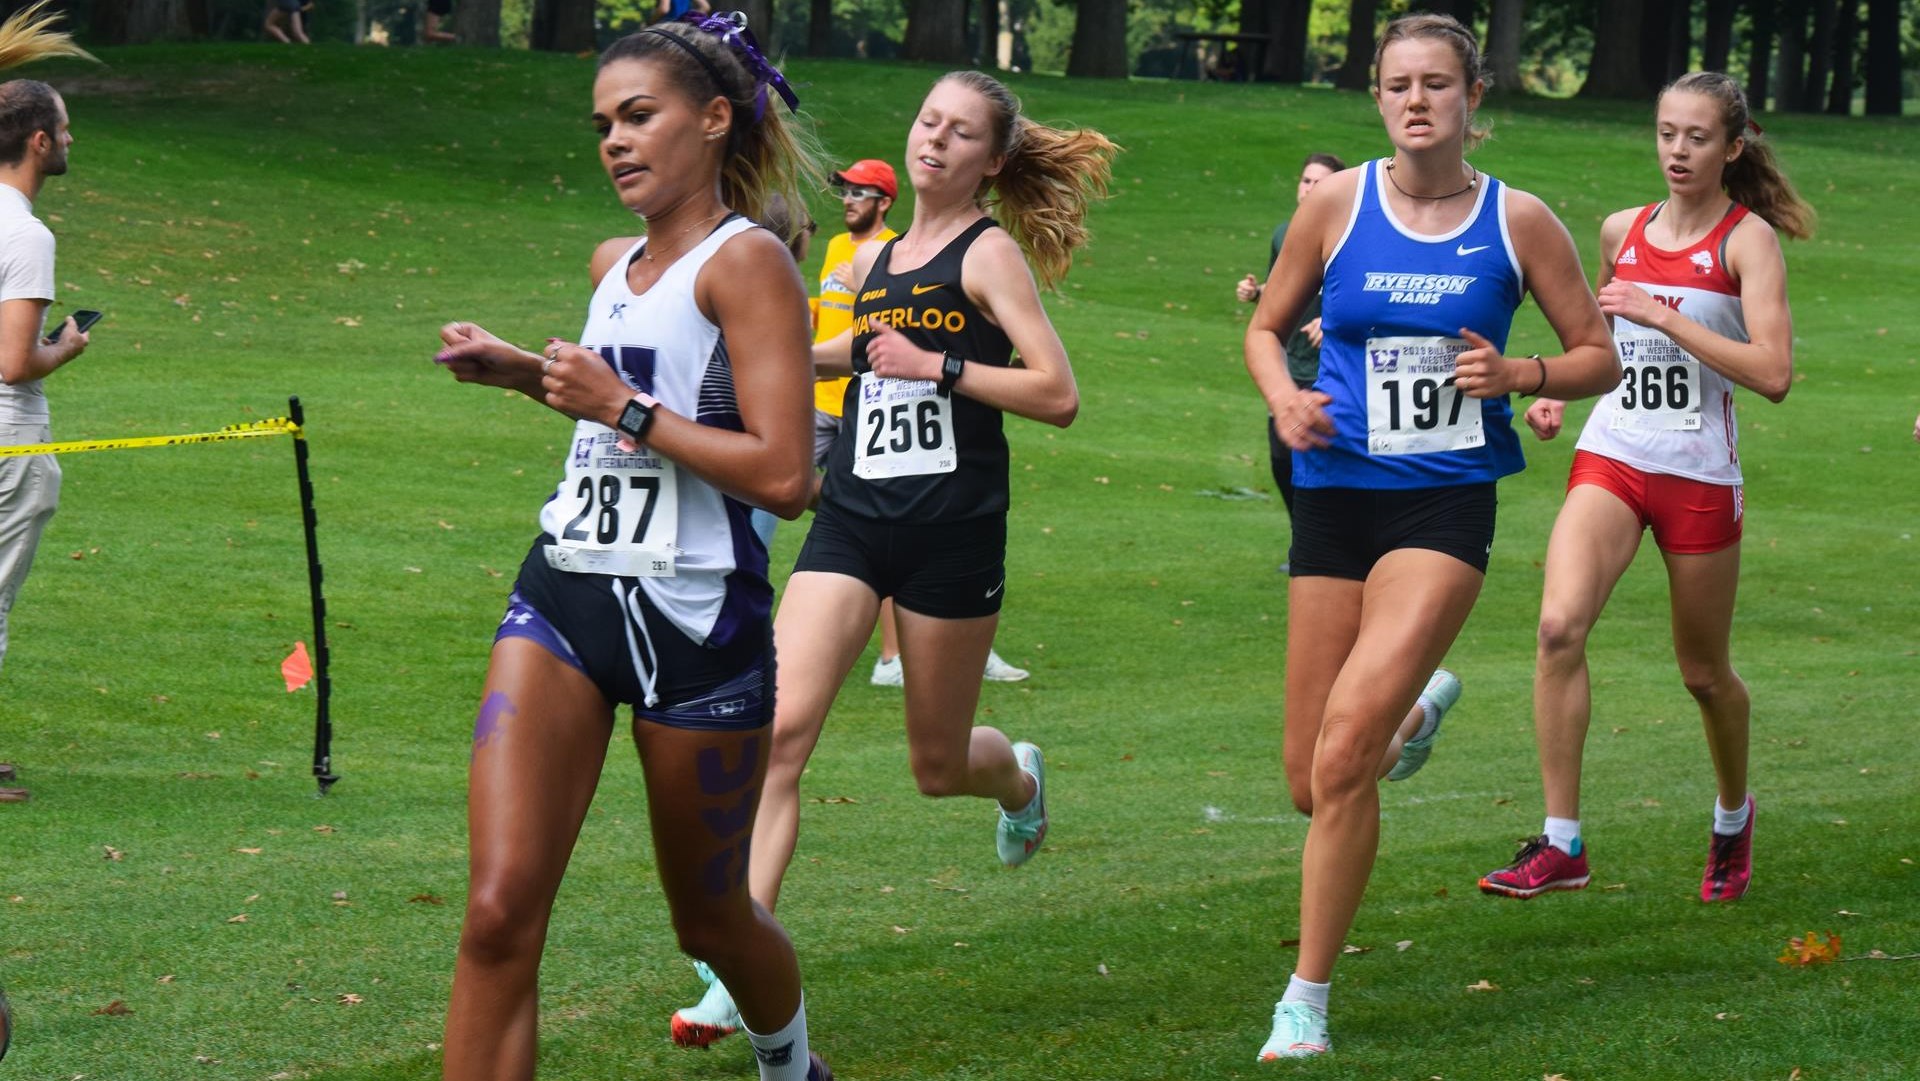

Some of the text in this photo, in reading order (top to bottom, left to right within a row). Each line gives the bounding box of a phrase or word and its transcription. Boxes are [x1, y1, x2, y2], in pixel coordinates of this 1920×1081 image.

[861, 288, 887, 302] OUA
[1363, 272, 1477, 294] RYERSON
[1389, 292, 1443, 304] RAMS
[1382, 376, 1464, 430] 197
[1621, 366, 1689, 410] 366
[866, 400, 943, 457] 256
[562, 474, 660, 545] 287
